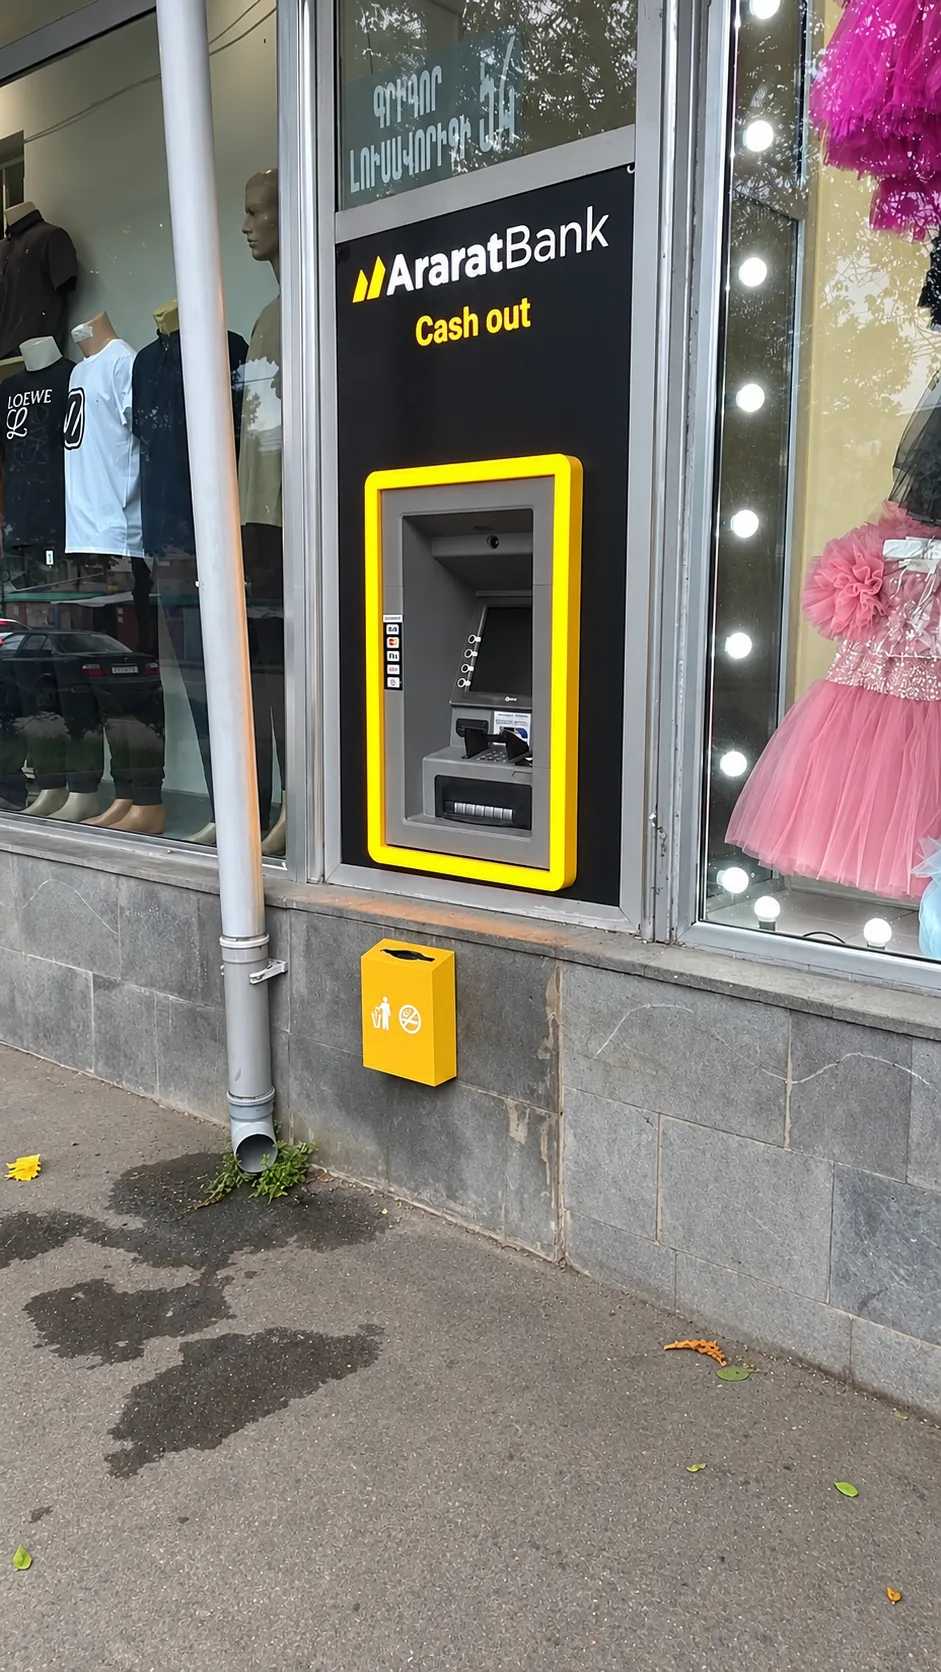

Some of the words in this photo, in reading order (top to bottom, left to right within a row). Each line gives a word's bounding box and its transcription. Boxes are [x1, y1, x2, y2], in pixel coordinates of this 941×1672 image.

[373, 65, 442, 129] ԳՐԻԳՈՐ
[386, 206, 609, 296] AraratBank
[415, 306, 479, 347] Cash
[486, 297, 532, 334] out
[7, 388, 53, 410] LOEWE
